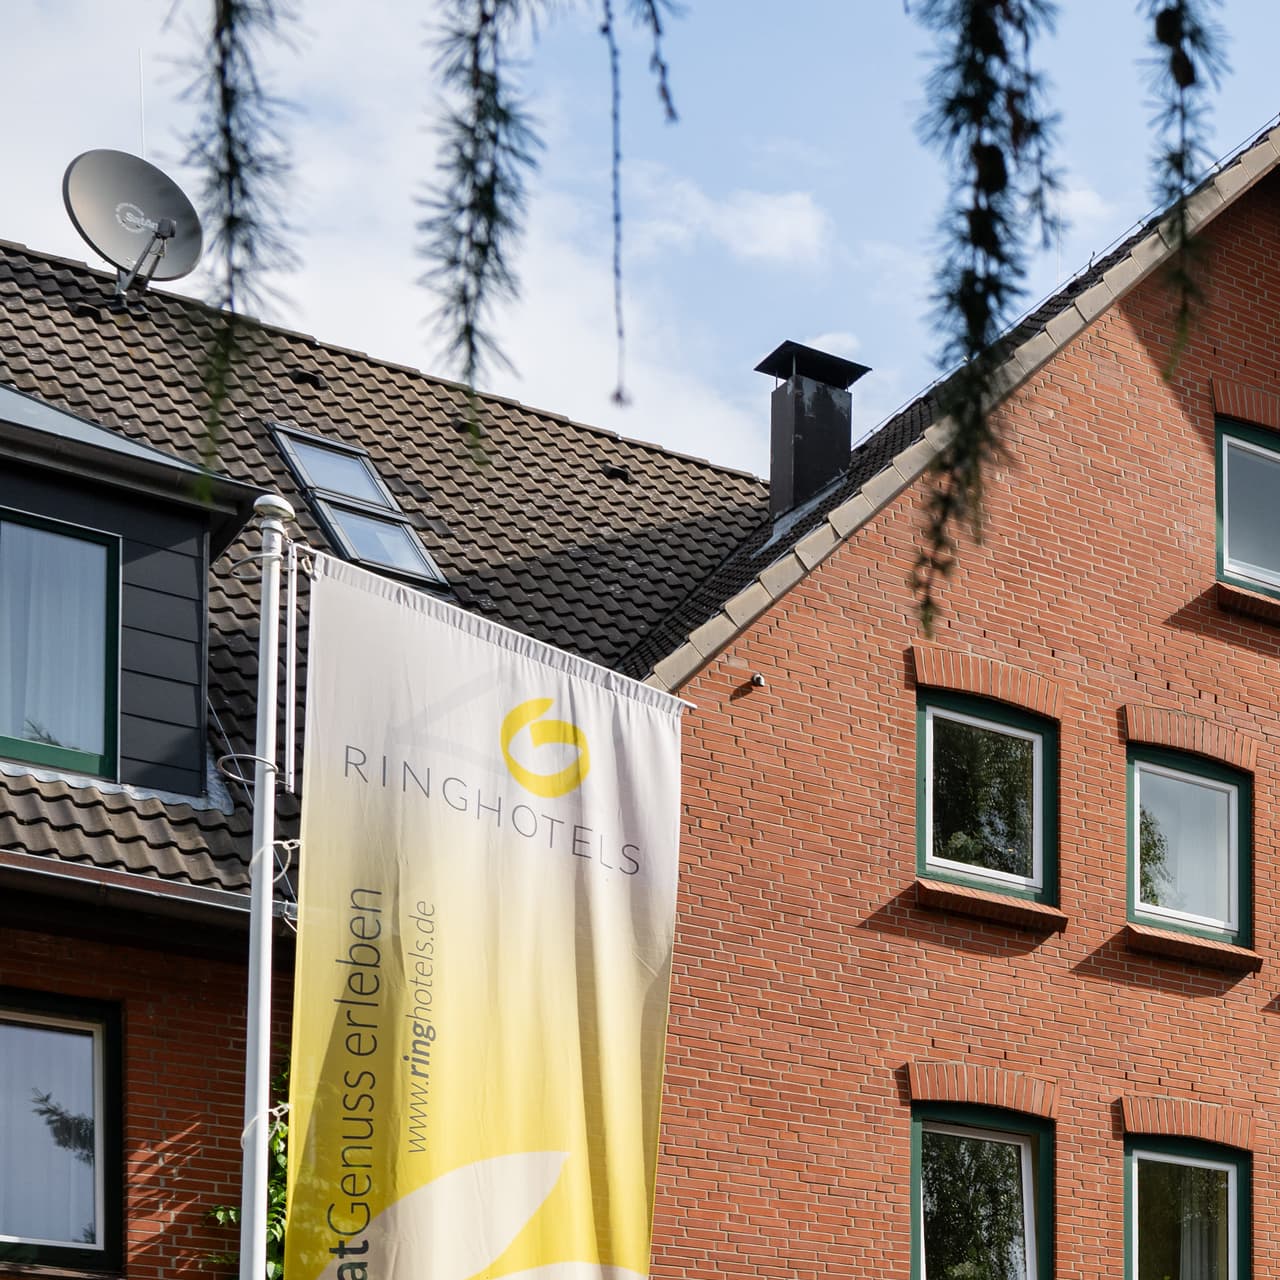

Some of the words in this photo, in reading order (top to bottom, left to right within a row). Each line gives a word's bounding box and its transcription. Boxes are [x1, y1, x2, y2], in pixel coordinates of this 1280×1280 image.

[344, 744, 641, 876] RINGHOTELS
[333, 887, 382, 1057] erleben
[402, 900, 437, 1154] www.ringhotels.de
